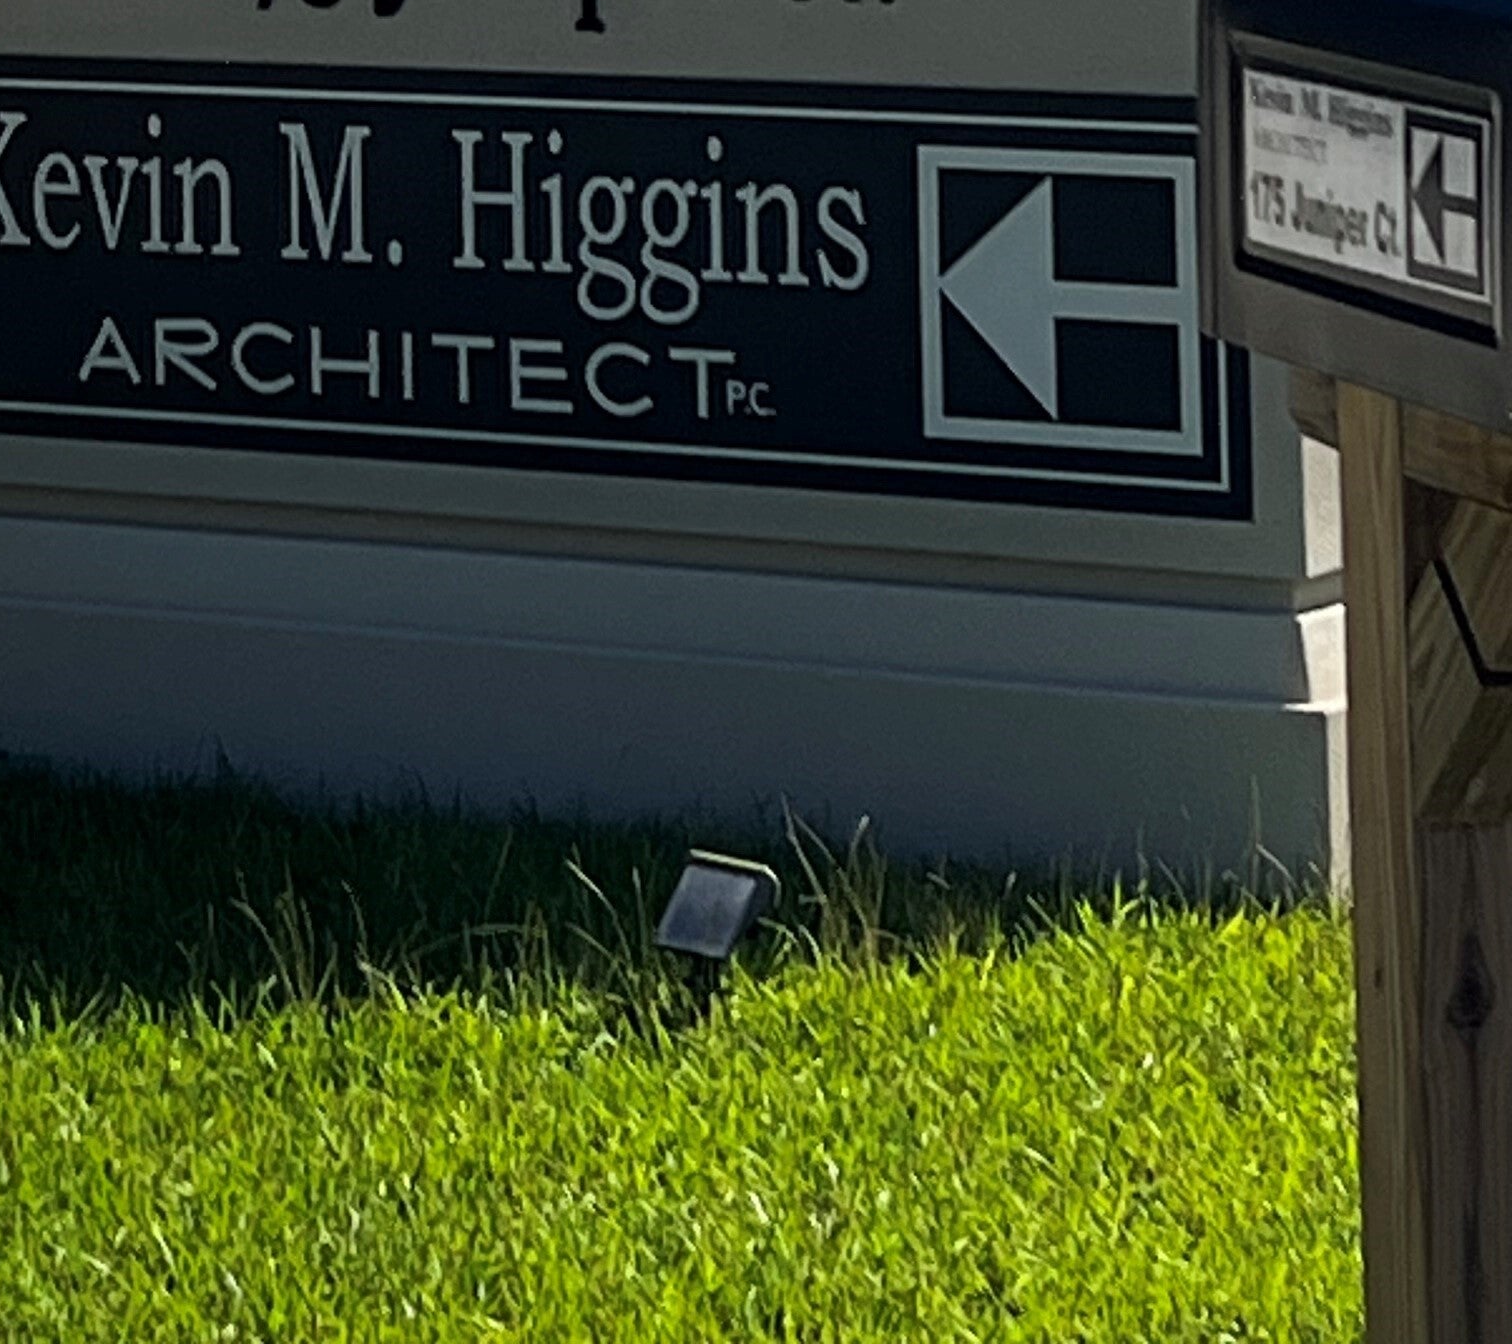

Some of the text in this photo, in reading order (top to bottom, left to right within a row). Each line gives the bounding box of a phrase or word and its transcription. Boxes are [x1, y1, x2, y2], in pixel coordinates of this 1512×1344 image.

[279, 122, 403, 266] M.
[451, 128, 869, 324] Higgins
[1251, 171, 1286, 227] 175
[78, 316, 736, 419] ARCHITECT
